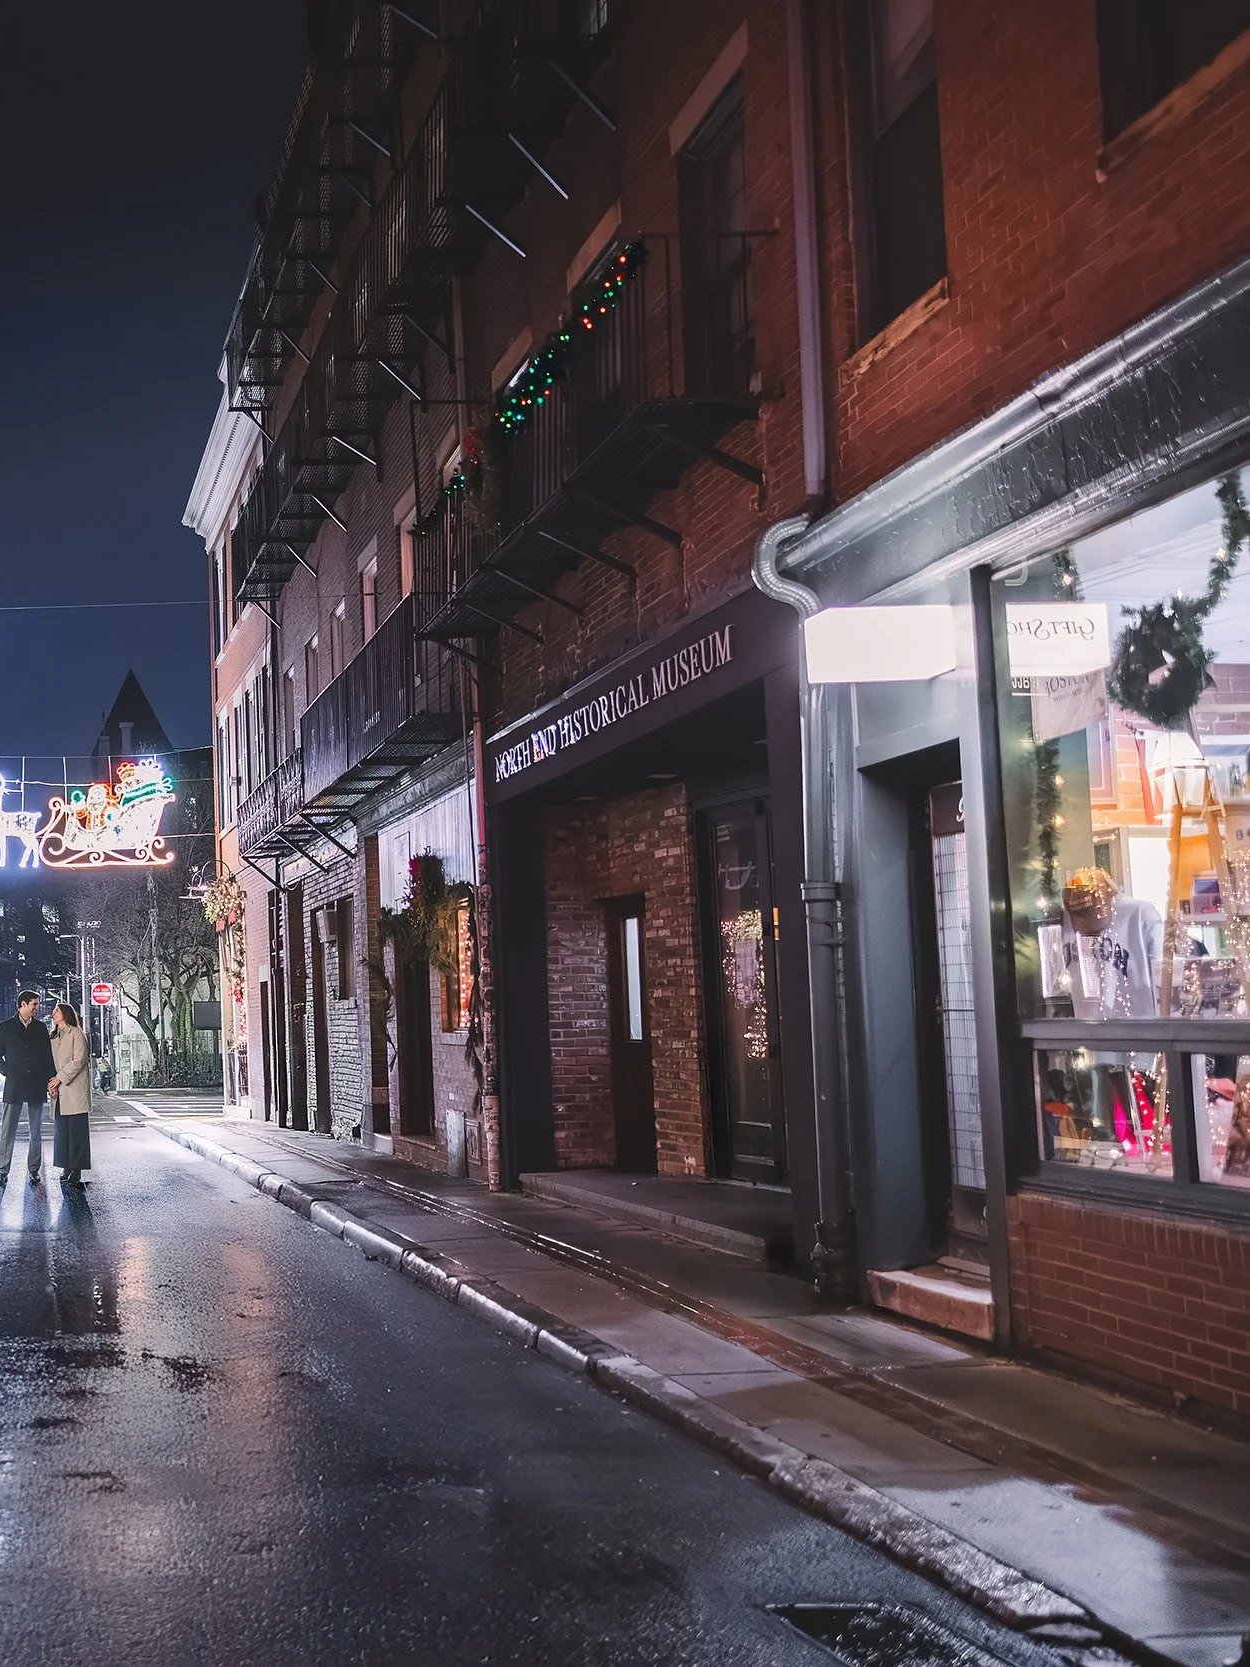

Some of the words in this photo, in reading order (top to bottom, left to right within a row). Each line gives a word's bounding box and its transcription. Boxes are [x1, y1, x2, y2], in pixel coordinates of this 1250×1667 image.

[494, 738, 533, 783] NORTH
[530, 724, 557, 764] END
[557, 673, 649, 750] HISTORICAL
[651, 624, 736, 701] MUSEUM
